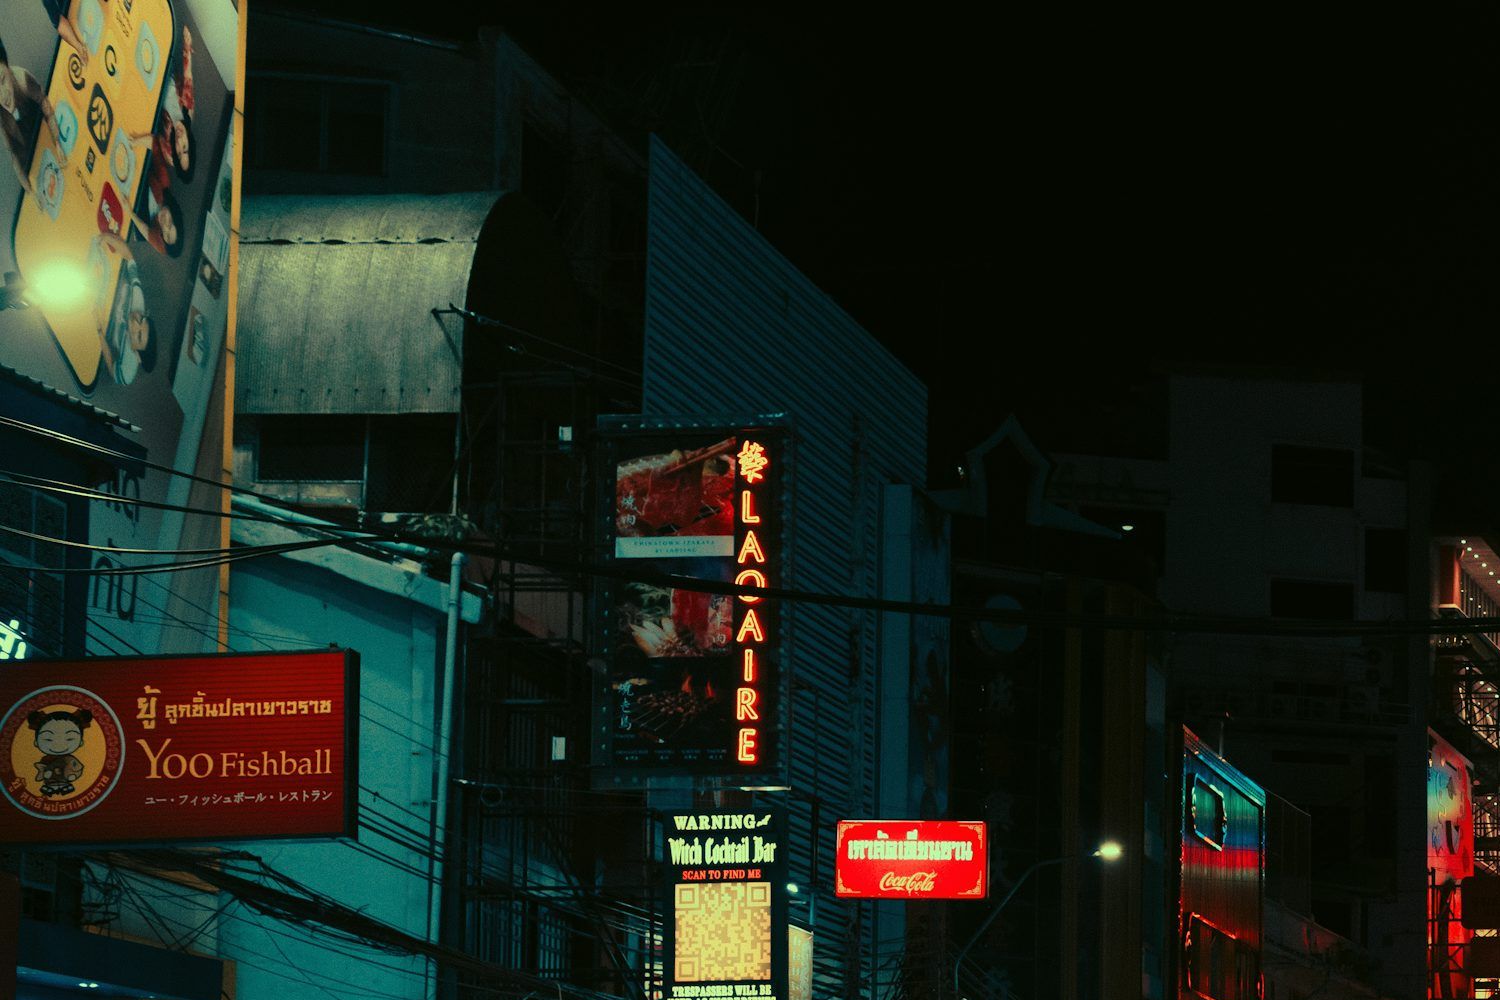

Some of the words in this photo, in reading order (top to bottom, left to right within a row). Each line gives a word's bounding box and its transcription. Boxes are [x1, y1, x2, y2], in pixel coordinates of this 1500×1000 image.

[220, 749, 332, 778] Fishball
[674, 814, 756, 830] WARNING
[668, 837, 702, 865] Witch
[705, 836, 749, 865] Cocktail
[752, 836, 776, 864] Bar
[682, 871, 706, 881] SCAN
[708, 870, 721, 880] TO
[723, 870, 745, 879] FIND
[747, 869, 761, 879] ME
[672, 985, 733, 997] TRESPASSERS
[735, 985, 759, 996] WILL
[760, 984, 772, 996] BE
